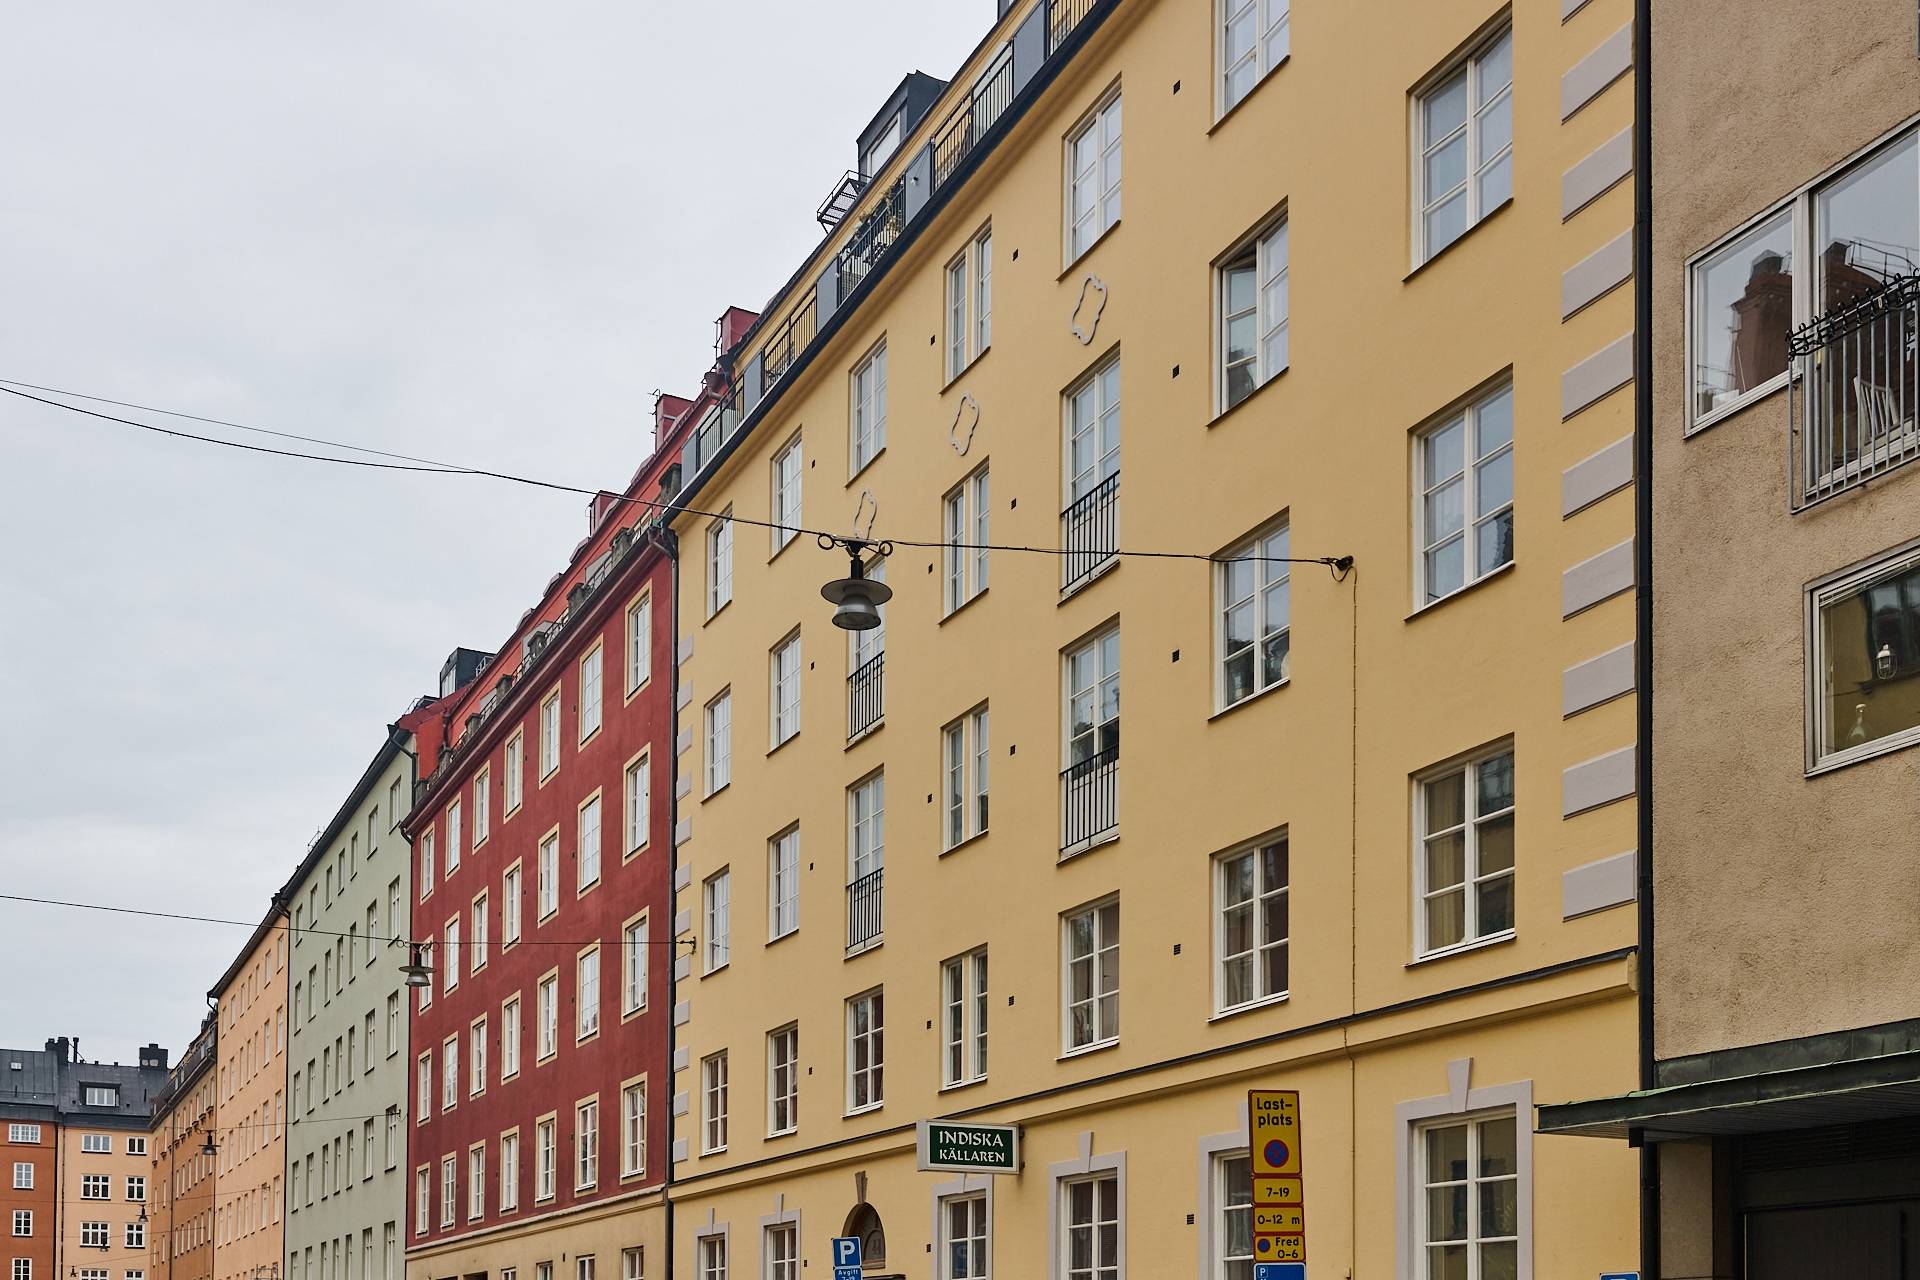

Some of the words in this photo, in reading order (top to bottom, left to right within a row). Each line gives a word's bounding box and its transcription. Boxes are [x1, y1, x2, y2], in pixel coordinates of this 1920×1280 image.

[1256, 1097, 1293, 1111] Last-
[1257, 1113, 1293, 1129] plats
[939, 1130, 1004, 1147] INDISKA
[939, 1147, 1005, 1163] KÄLLAREN
[1266, 1187, 1290, 1198] 7-19
[1257, 1214, 1283, 1225] 0-12
[1291, 1216, 1300, 1225] m
[1275, 1236, 1300, 1247] Fred
[840, 1240, 856, 1265] P
[1277, 1249, 1299, 1259] 0-6
[838, 1269, 859, 1277] Avgift
[1259, 1267, 1266, 1277] P
